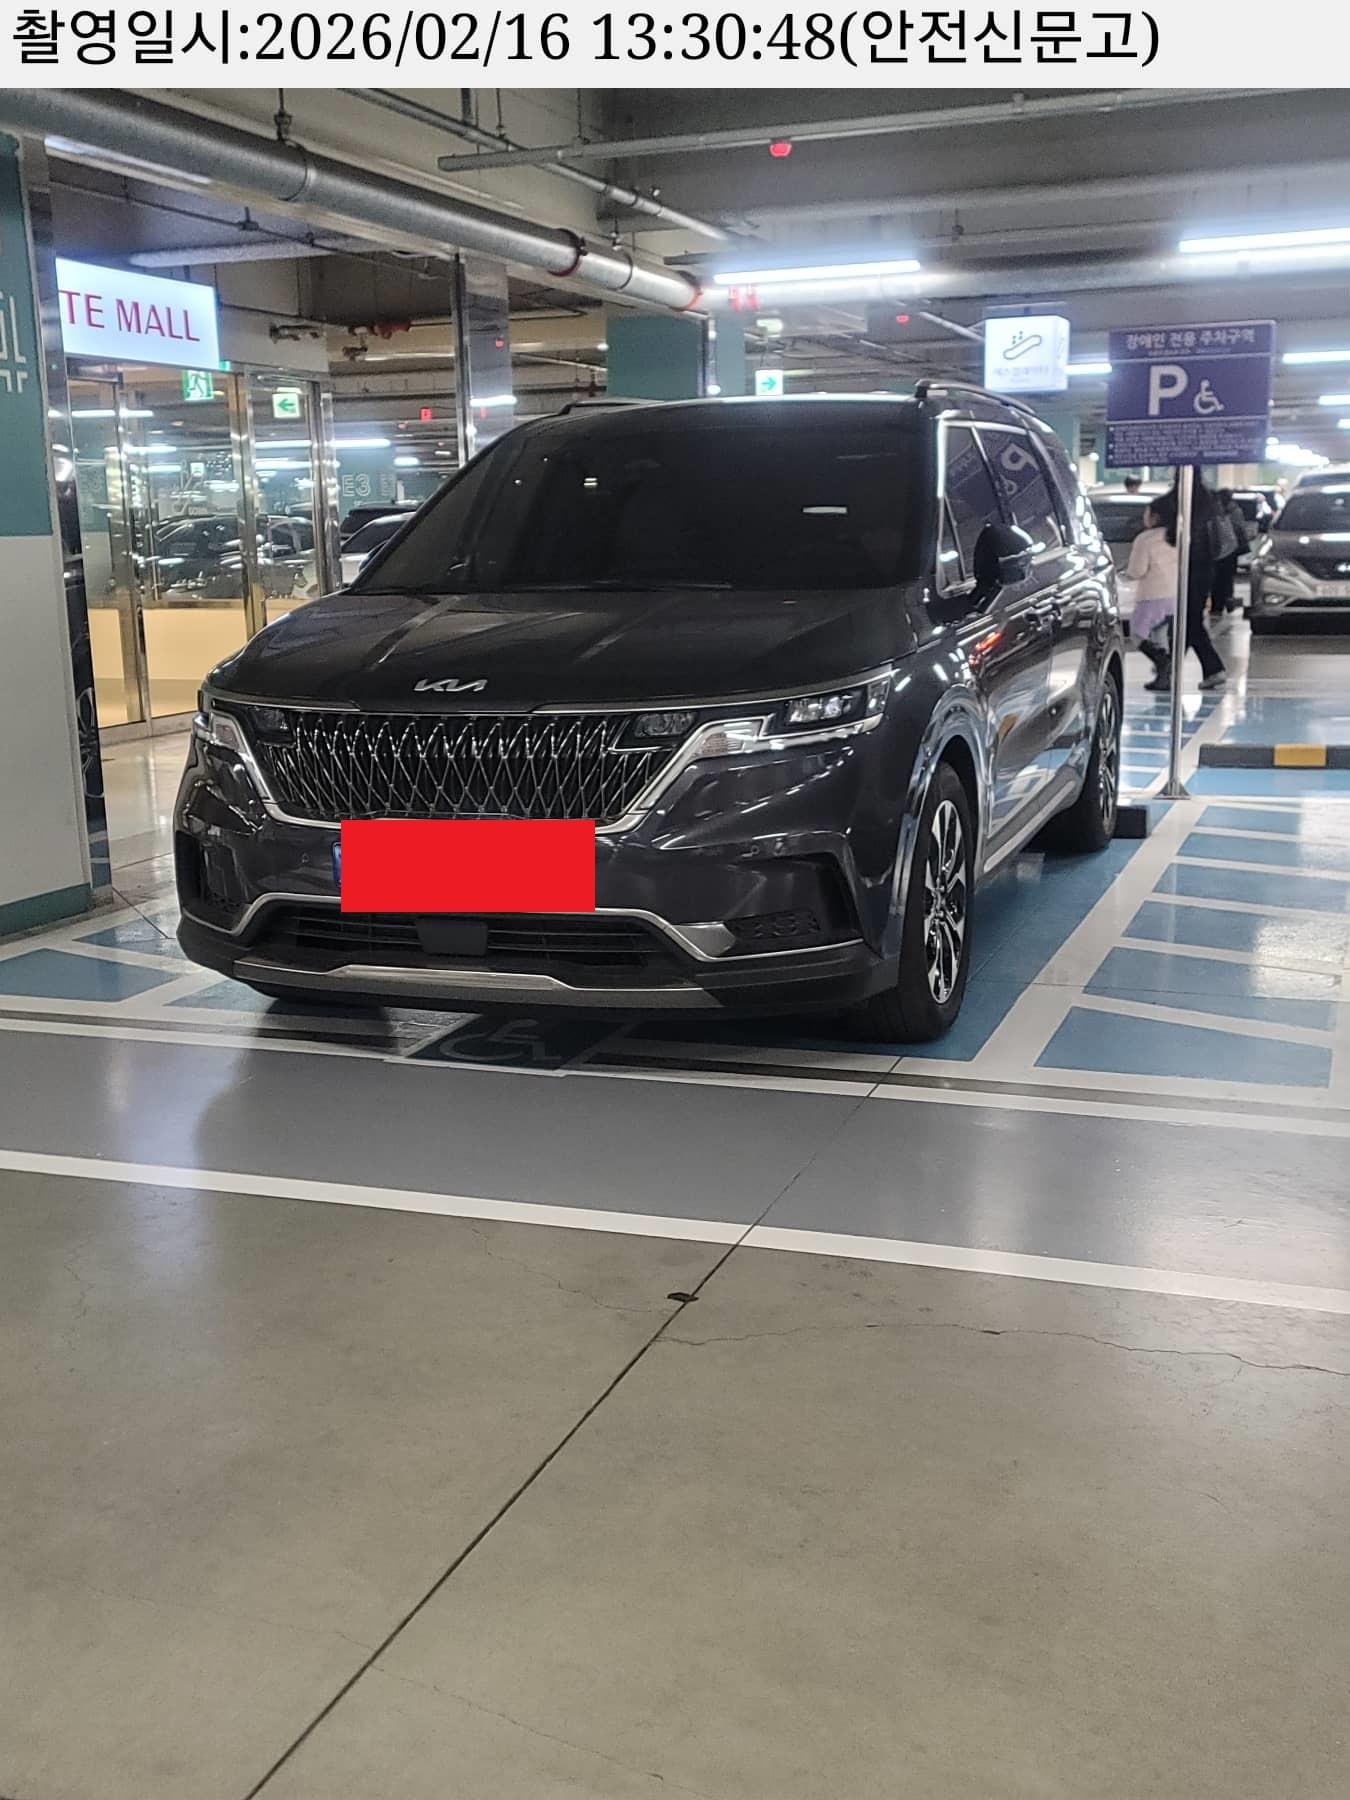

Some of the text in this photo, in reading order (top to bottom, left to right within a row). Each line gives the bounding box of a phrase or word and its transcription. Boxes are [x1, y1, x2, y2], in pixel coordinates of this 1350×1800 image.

[115, 298, 201, 342] MALL
[1148, 364, 1189, 416] P
[341, 473, 371, 497] E3
[413, 678, 488, 692] KIA
